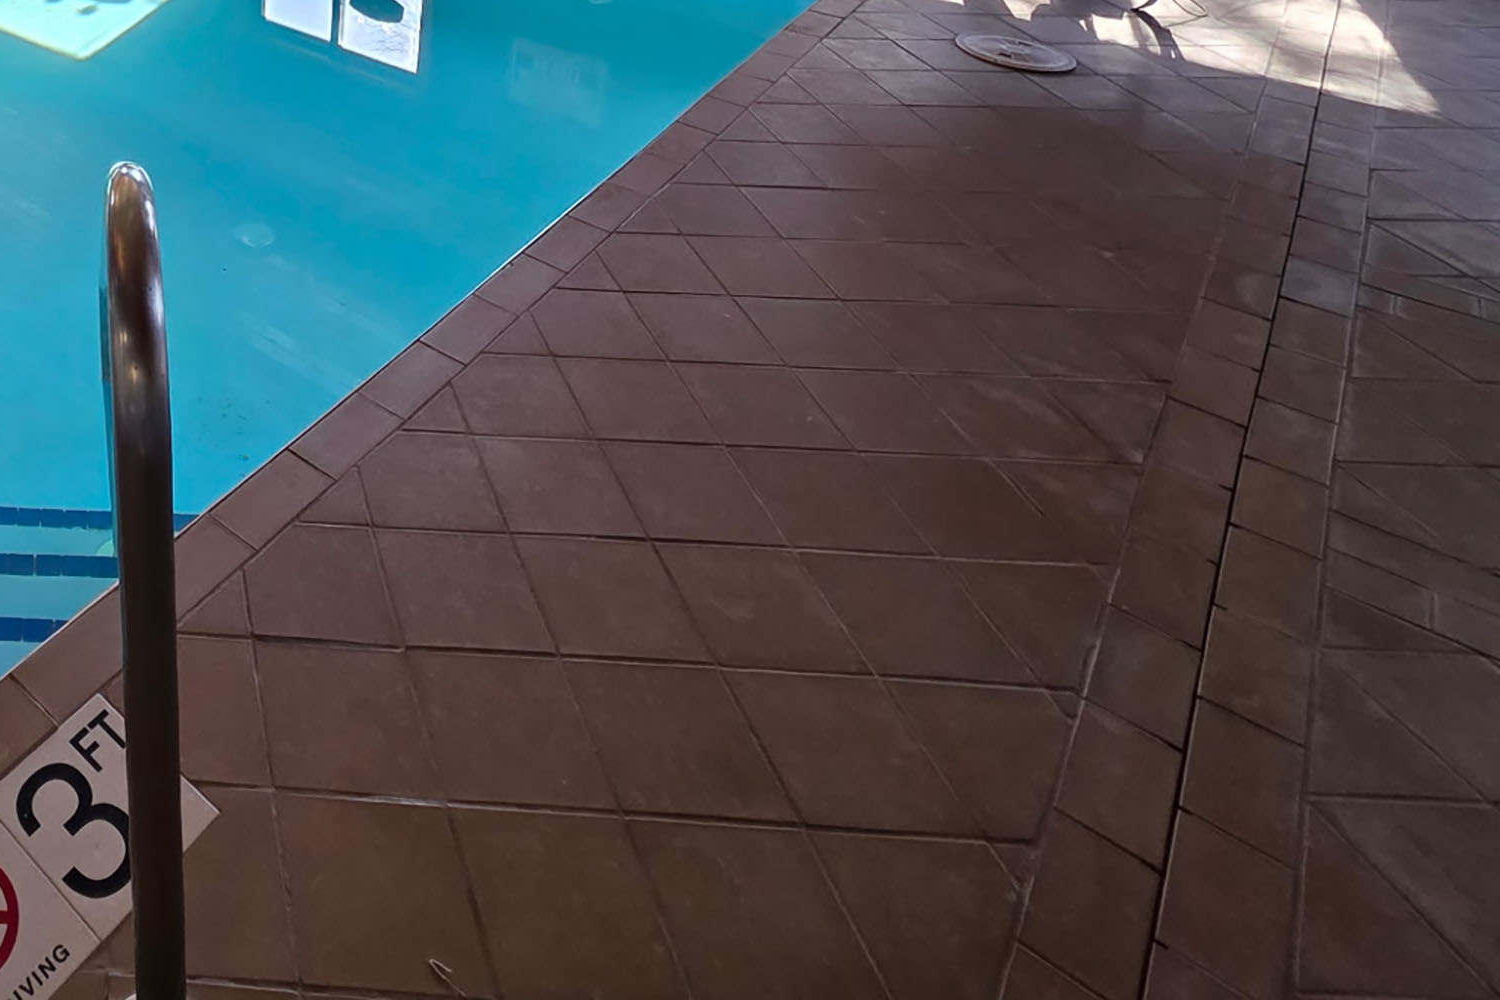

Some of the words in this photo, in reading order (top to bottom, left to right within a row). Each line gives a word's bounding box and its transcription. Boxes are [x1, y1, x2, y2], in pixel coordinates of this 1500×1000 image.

[69, 709, 126, 772] FT
[16, 762, 133, 899] 3
[8, 944, 71, 1000] IVING
